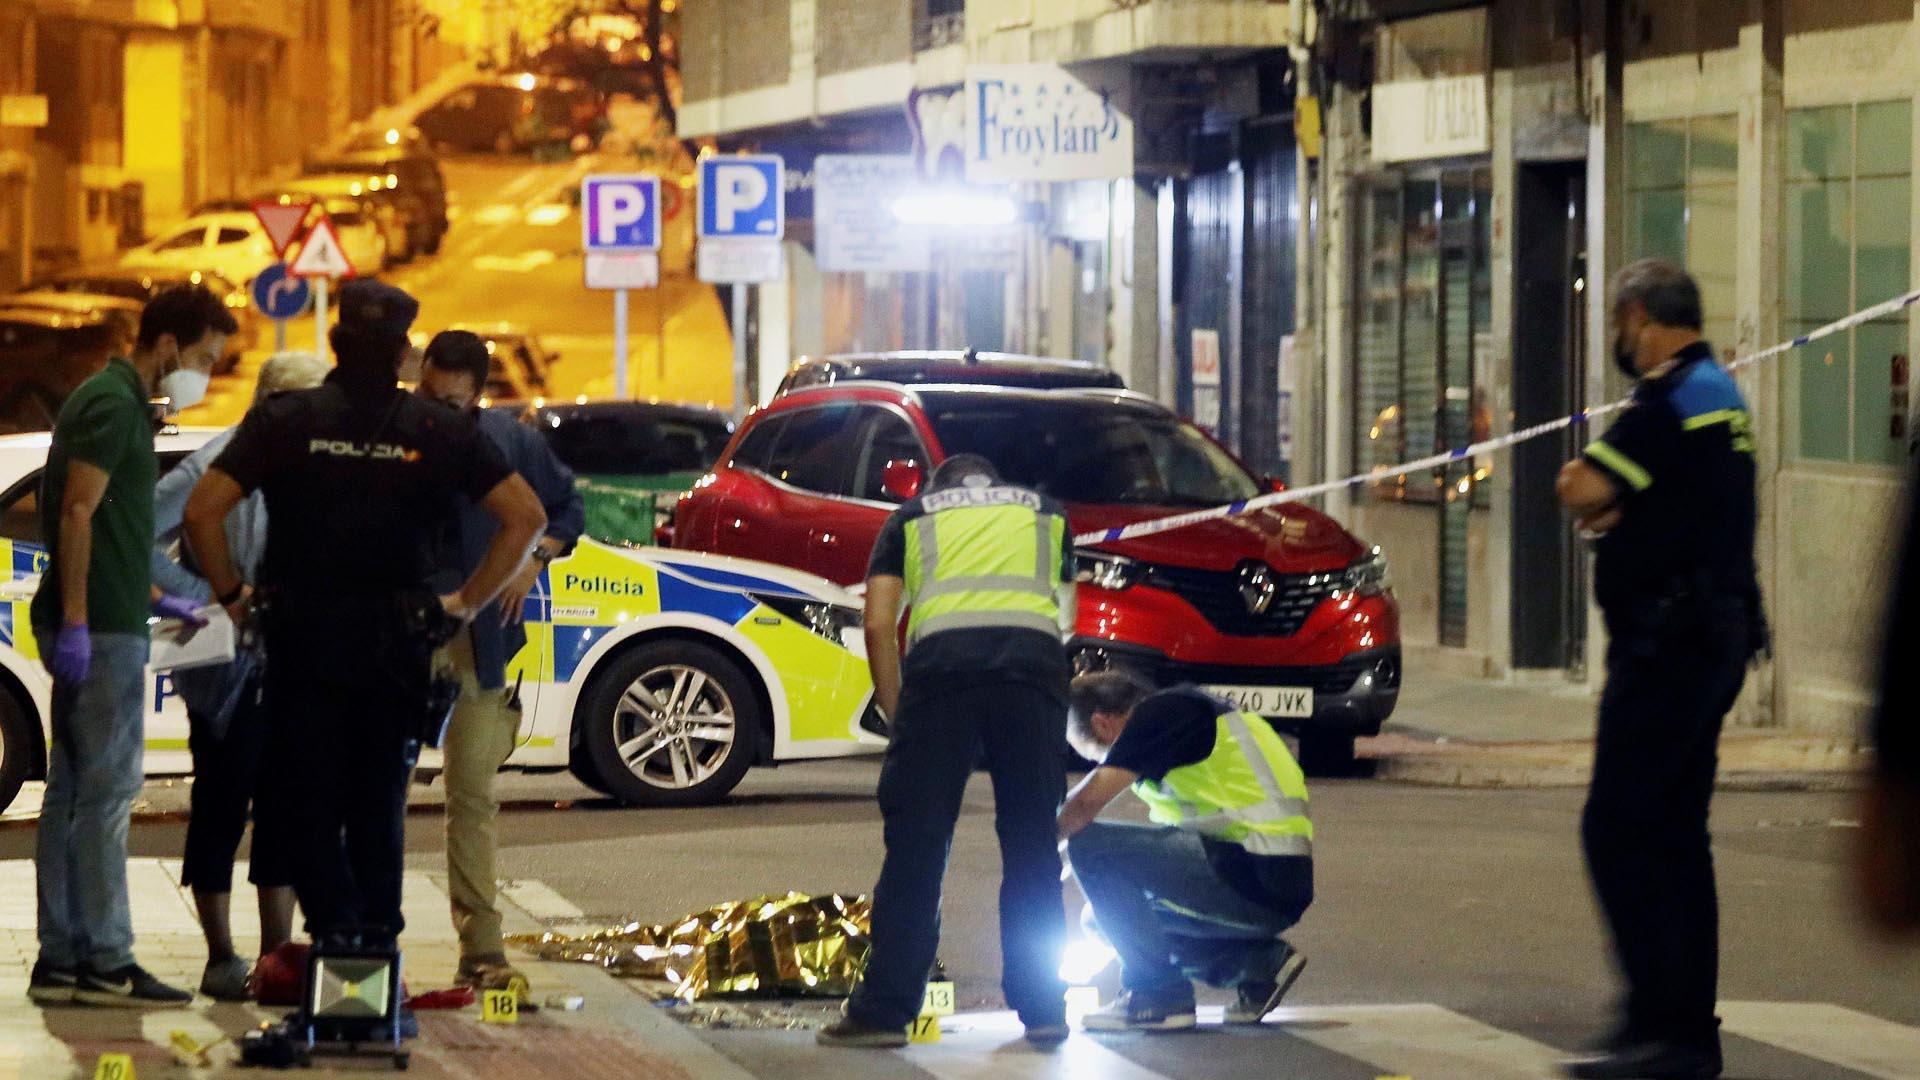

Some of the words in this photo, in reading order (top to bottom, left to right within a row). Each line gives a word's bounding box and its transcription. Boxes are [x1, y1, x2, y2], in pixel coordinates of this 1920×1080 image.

[977, 79, 1098, 167] Froylán
[598, 184, 645, 244] P
[716, 166, 768, 231] P
[1271, 692, 1305, 712] JVK
[490, 996, 513, 1014] 18
[913, 1016, 933, 1035] 17
